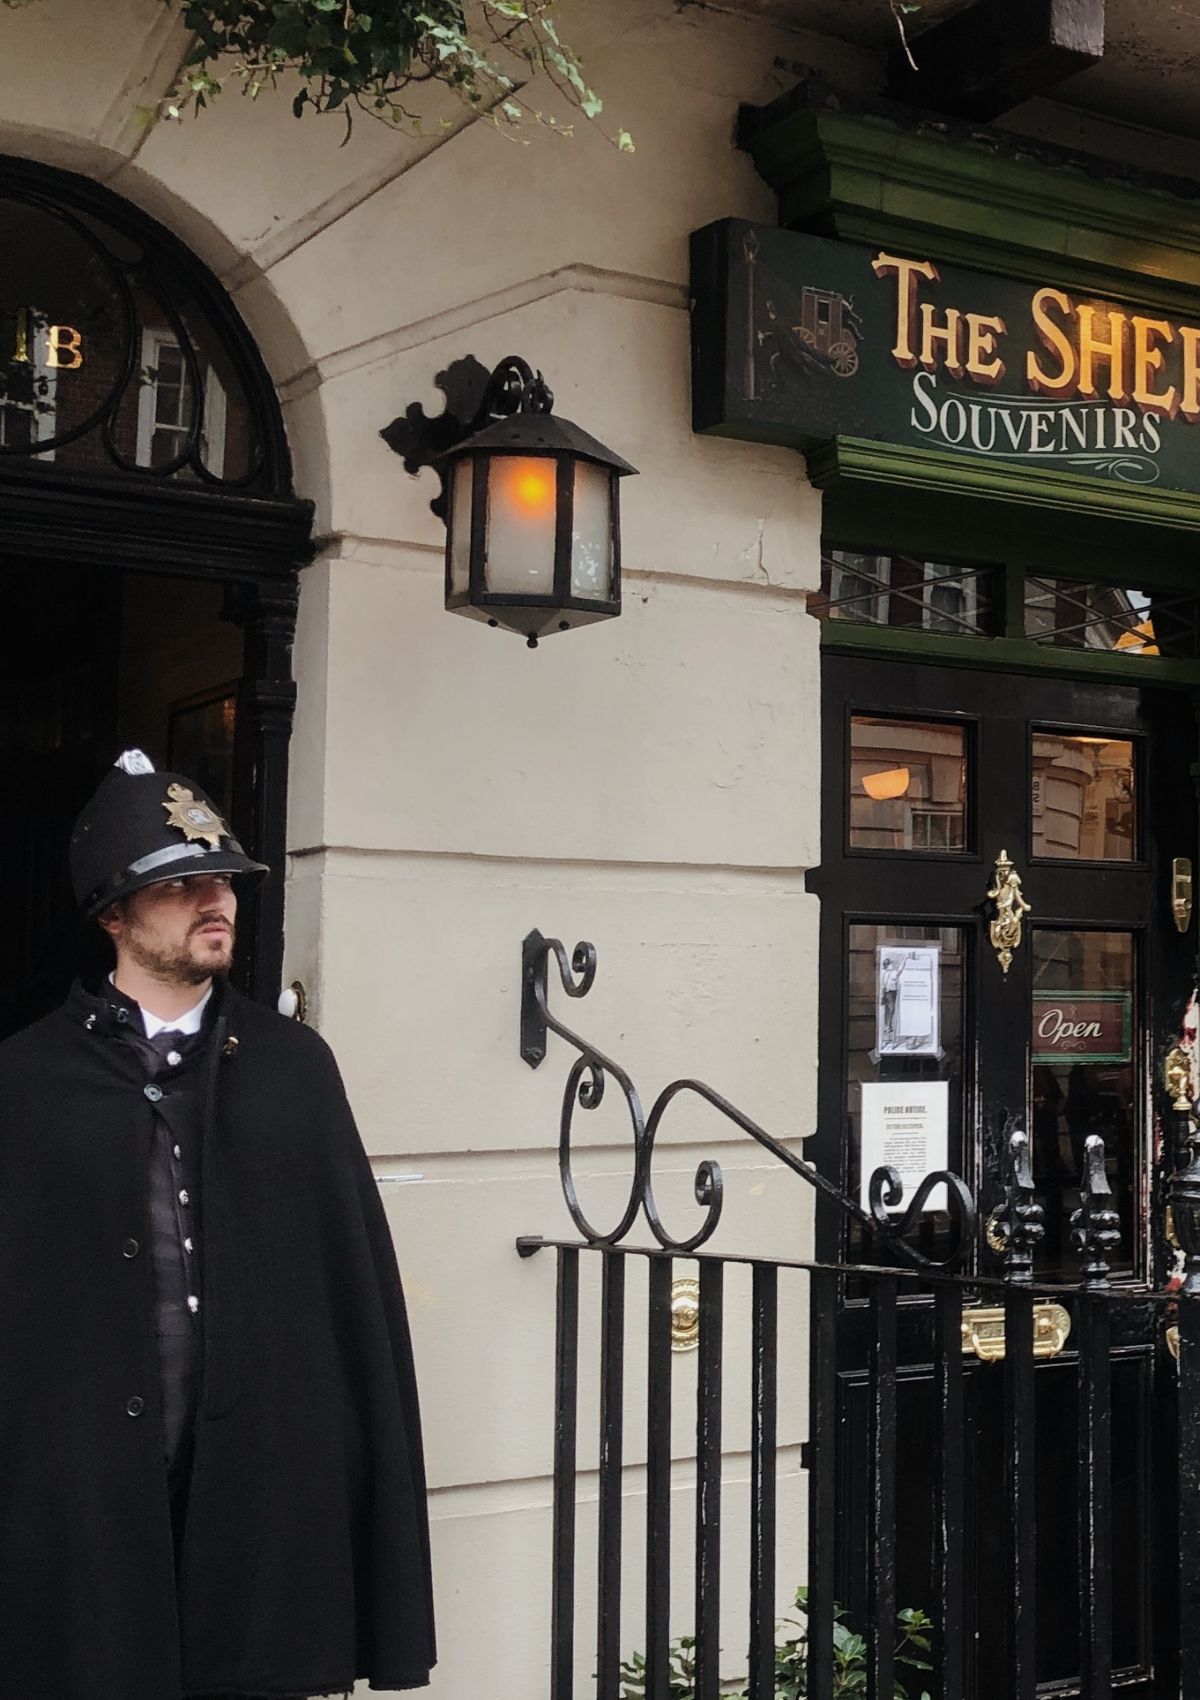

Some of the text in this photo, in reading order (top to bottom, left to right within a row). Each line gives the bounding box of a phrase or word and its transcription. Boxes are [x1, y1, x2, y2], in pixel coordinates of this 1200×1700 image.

[871, 251, 1005, 382] THE
[911, 371, 1160, 453] SOUVENIRS
[1038, 1009, 1102, 1045] Open
